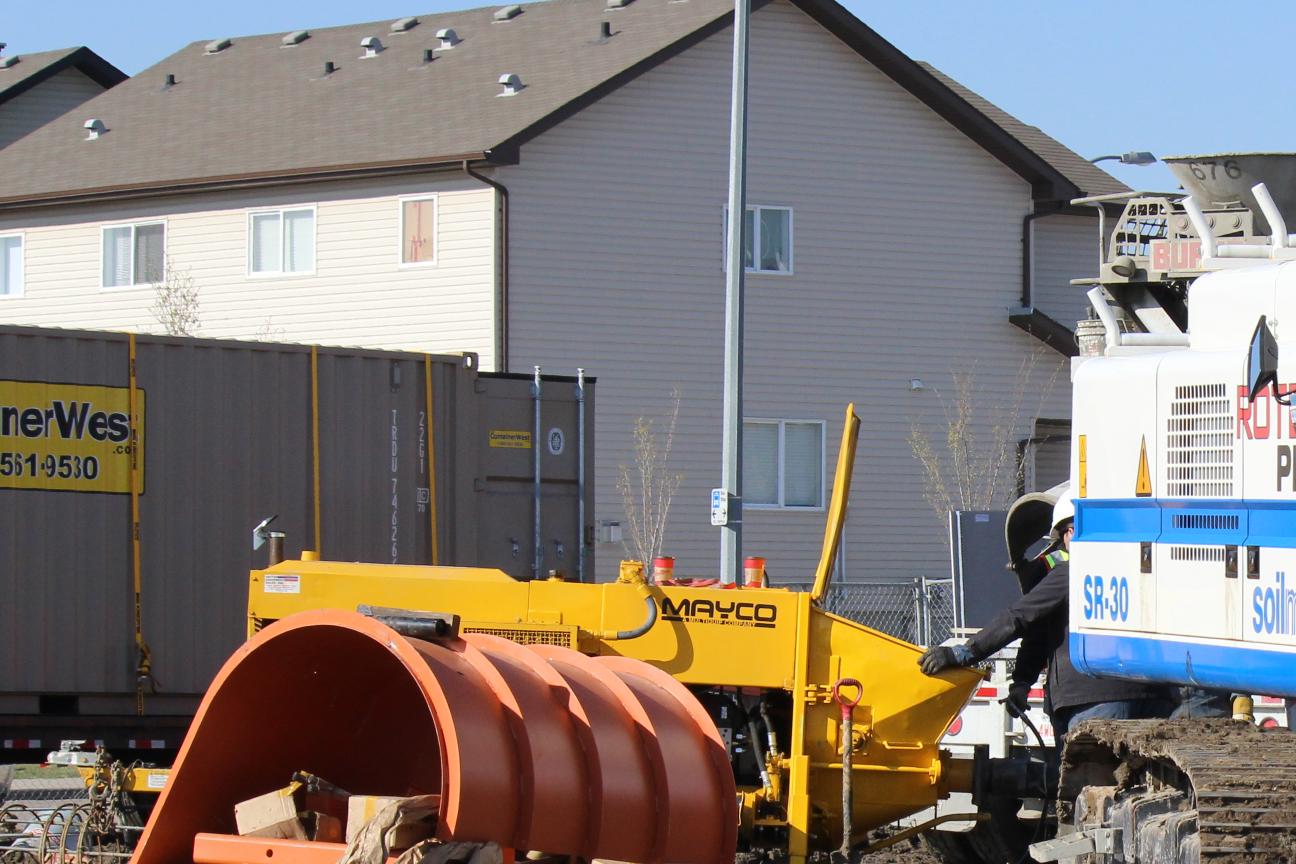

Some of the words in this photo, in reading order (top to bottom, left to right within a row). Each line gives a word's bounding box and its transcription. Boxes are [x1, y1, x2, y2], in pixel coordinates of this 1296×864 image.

[1189, 160, 1242, 180] 676
[1, 400, 139, 443] nerWes
[661, 597, 777, 622] MAYCO
[1083, 574, 1129, 622] SR-30
